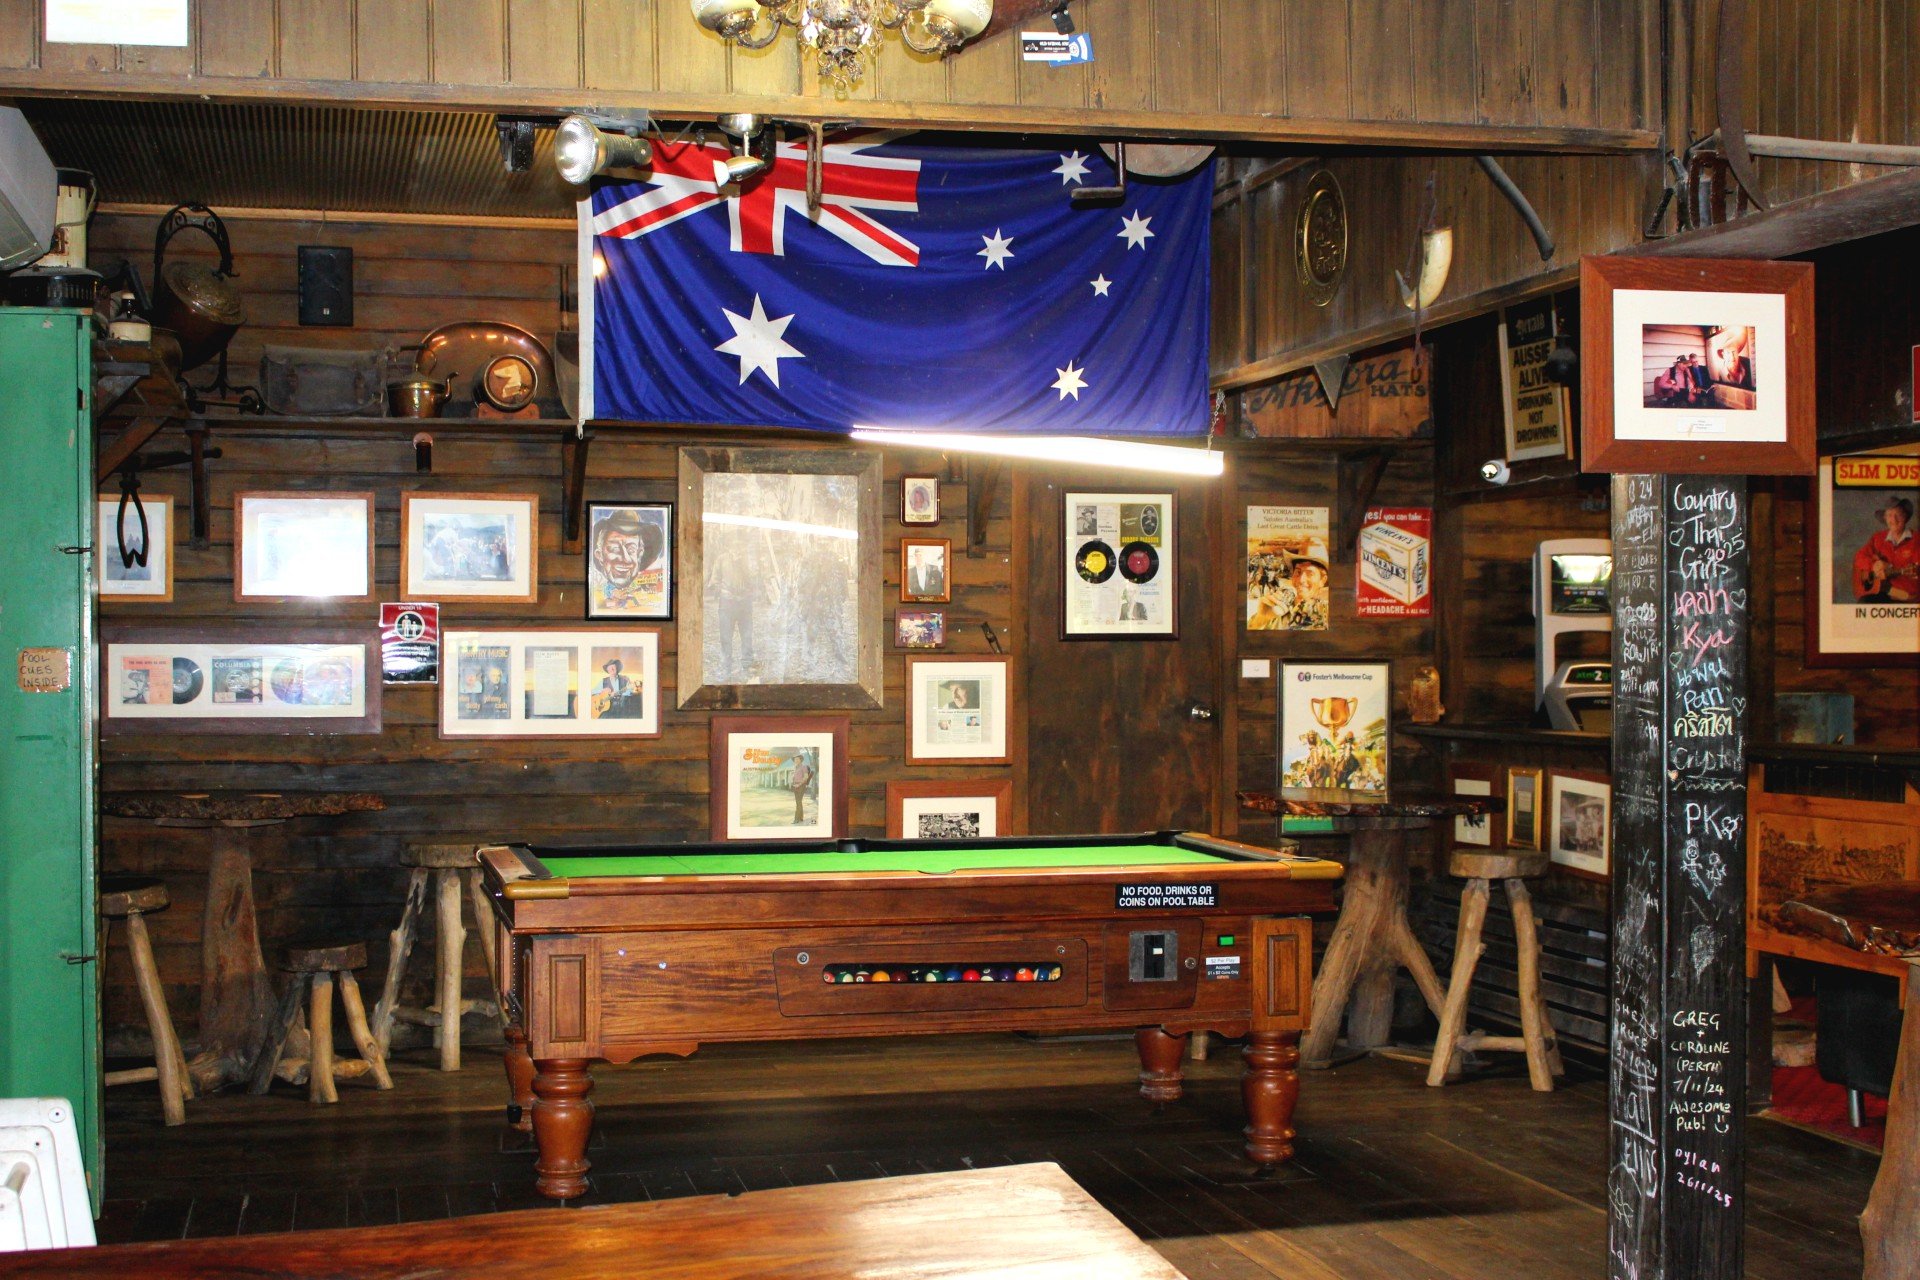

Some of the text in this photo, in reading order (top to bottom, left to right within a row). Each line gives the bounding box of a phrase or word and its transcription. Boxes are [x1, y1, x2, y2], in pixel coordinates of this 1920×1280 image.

[1371, 384, 1427, 397] HATS
[1528, 411, 1544, 425] NOT
[1516, 425, 1558, 443] DROWNING
[1839, 464, 1880, 479] SLIM
[1674, 483, 1737, 529] Country
[1384, 514, 1395, 522] you
[1367, 605, 1405, 614] HEADACHE
[1855, 608, 1867, 618] IN
[21, 651, 50, 662] POOL
[488, 650, 508, 658] MUSIC
[20, 665, 53, 675] CUES
[23, 677, 59, 687] INSIDE
[1362, 673, 1373, 681] Cup
[1122, 886, 1212, 896] NO FOOD, DRINKS OR
[1119, 896, 1215, 906] COINS ON POOL TABLE
[1673, 1010, 1721, 1031] GREG
[1676, 1057, 1722, 1075] (PERTH)
[1669, 1101, 1731, 1115] Awesome
[1676, 1114, 1706, 1131] Pub!
[1675, 1148, 1721, 1173] Dylan
